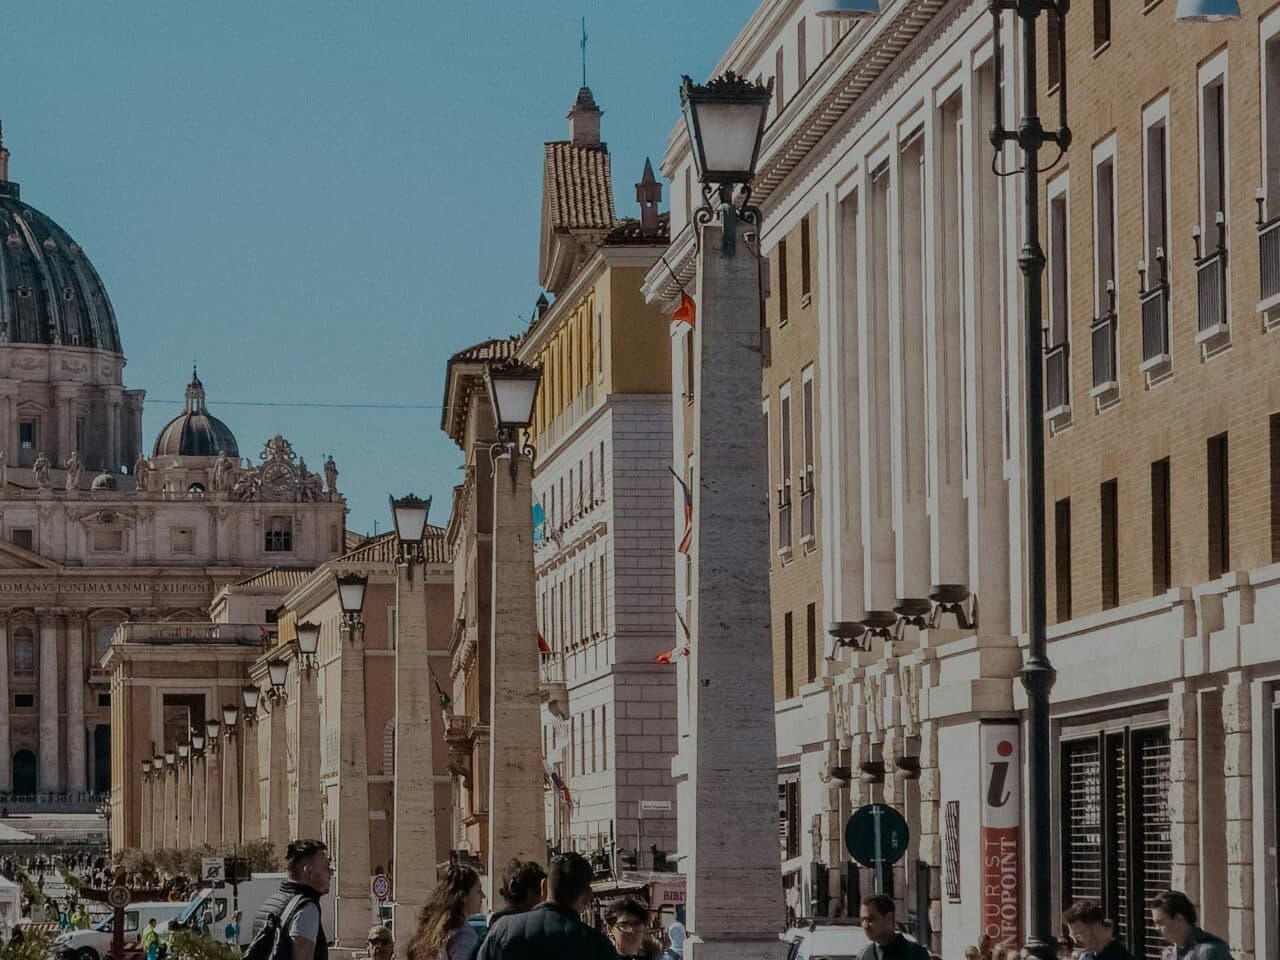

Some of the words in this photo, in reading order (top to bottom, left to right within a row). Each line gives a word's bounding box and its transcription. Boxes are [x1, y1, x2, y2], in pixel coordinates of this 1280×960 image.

[987, 740, 1013, 808] i
[985, 838, 1000, 939] OURIST
[1000, 836, 1017, 947] NFOPOINT
